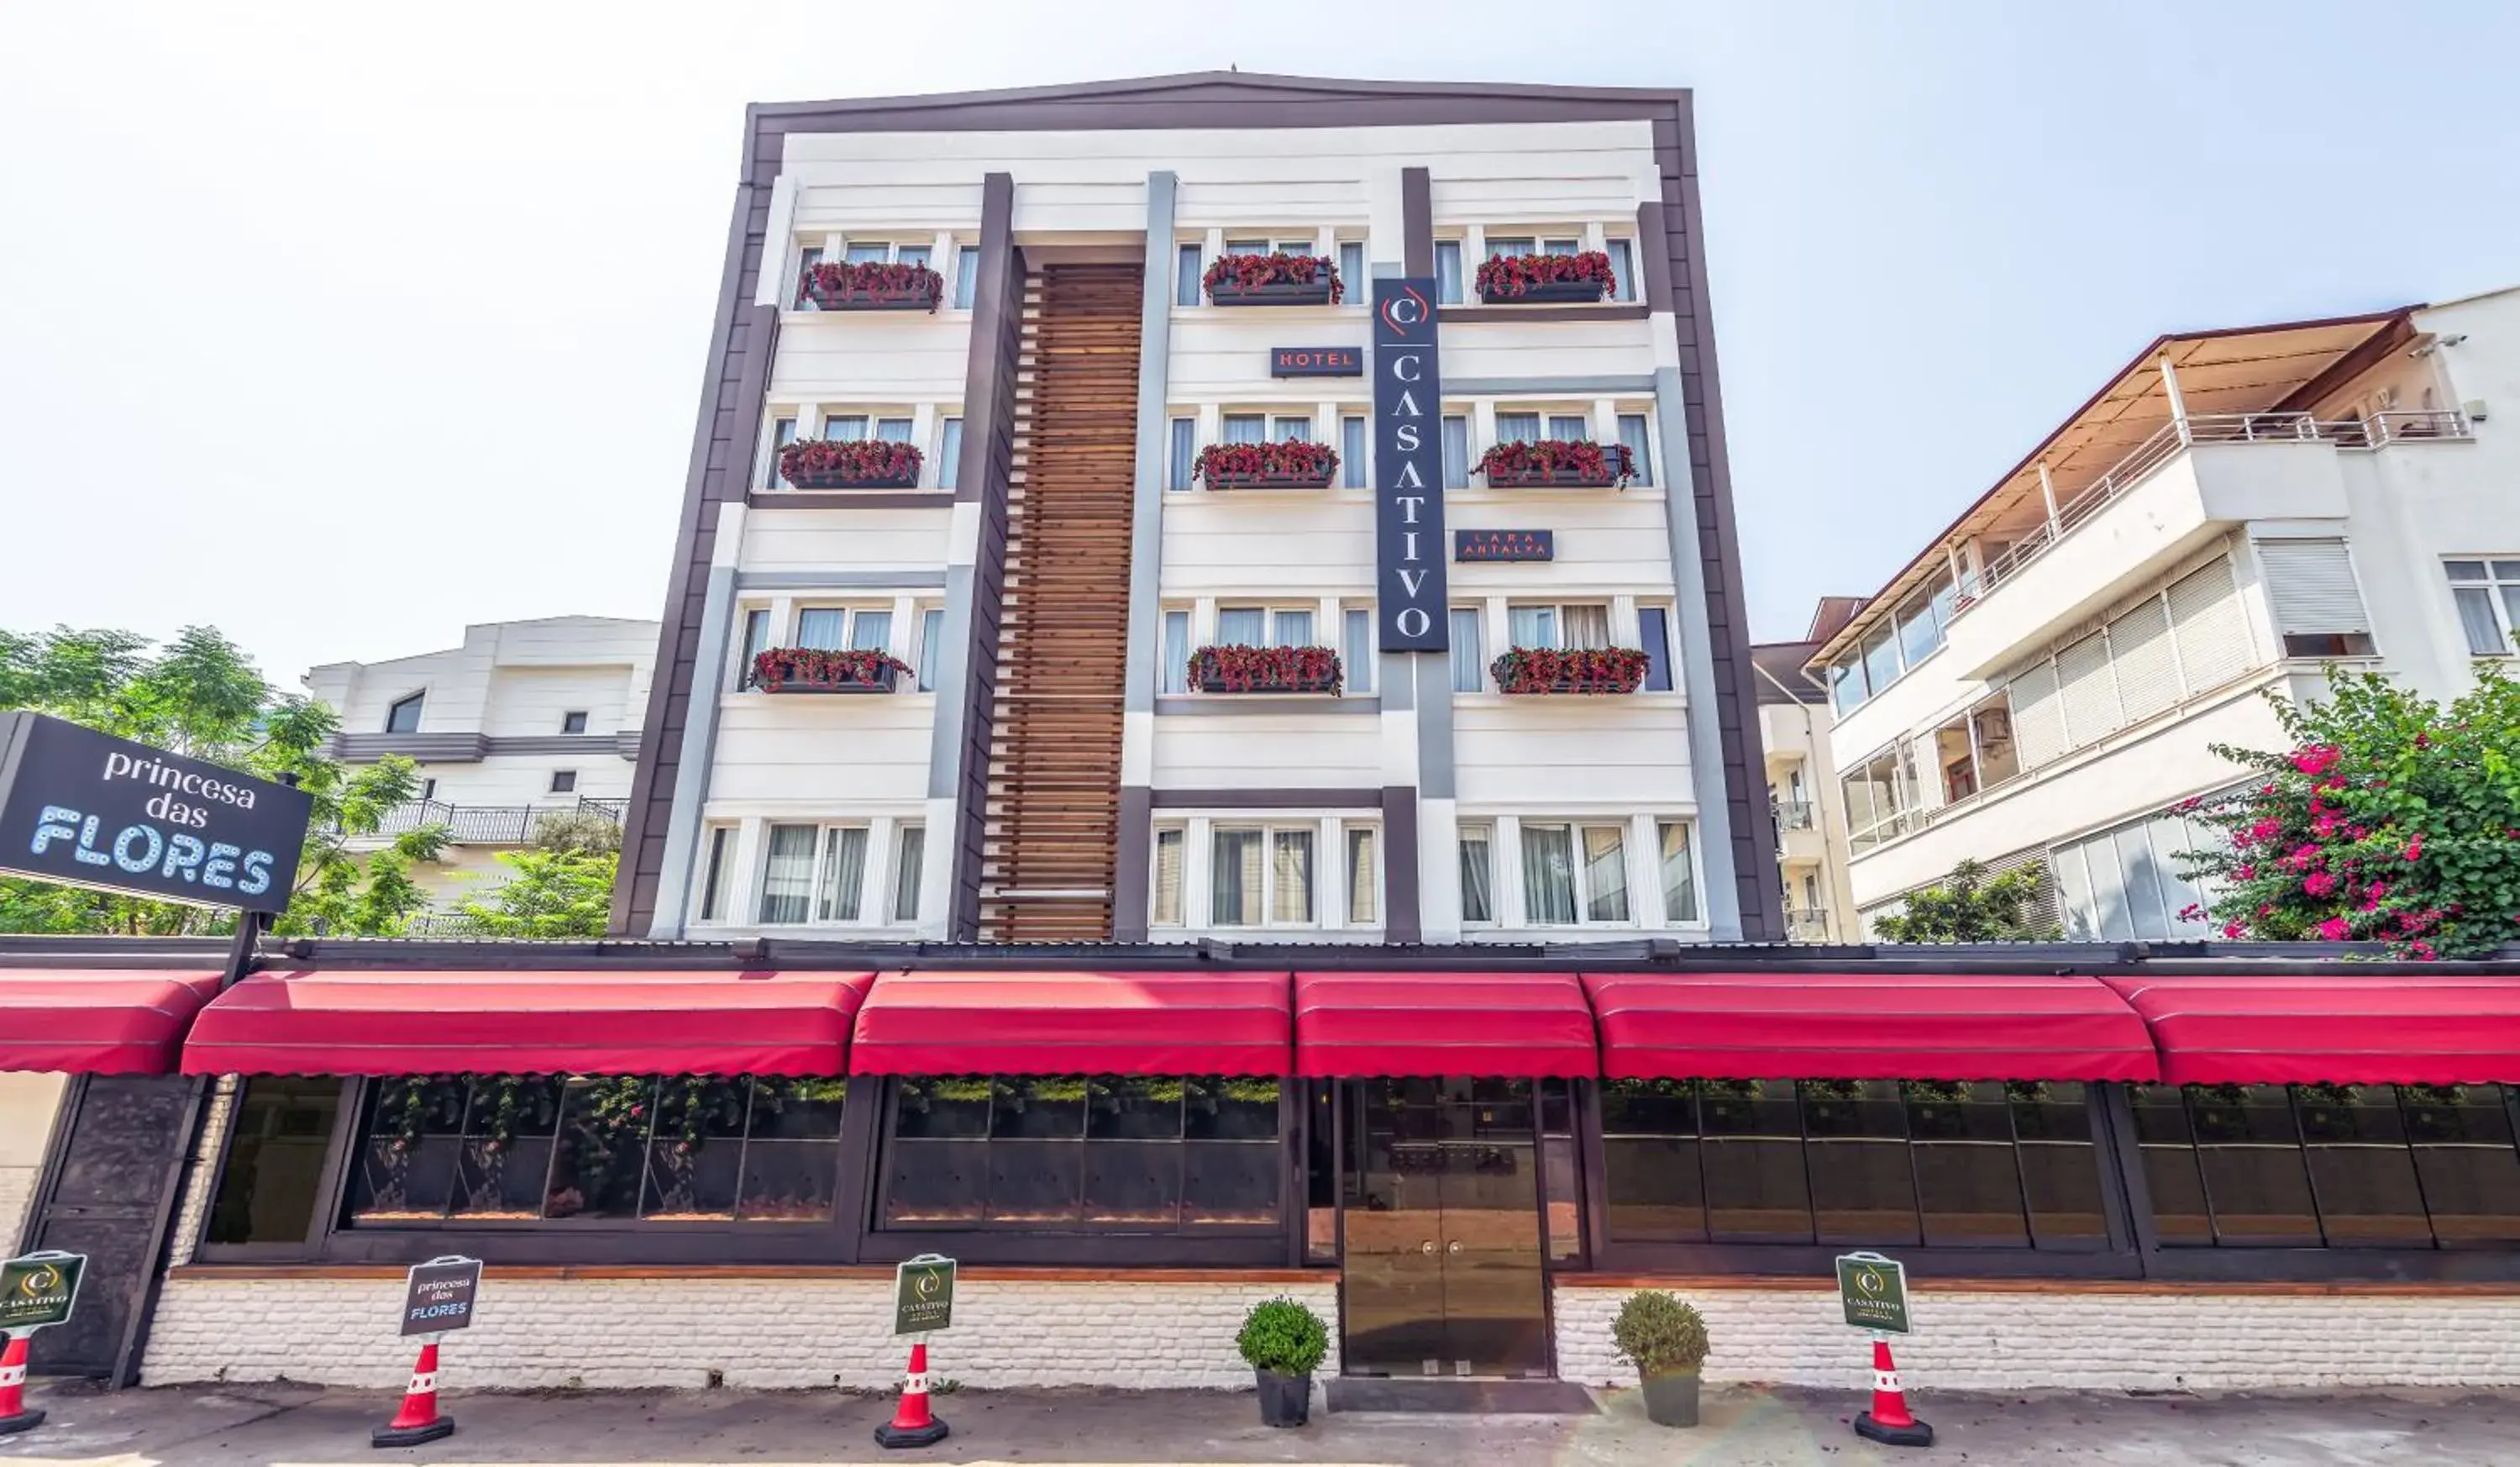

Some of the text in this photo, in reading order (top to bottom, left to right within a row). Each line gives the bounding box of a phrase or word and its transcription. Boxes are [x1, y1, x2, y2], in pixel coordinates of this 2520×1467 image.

[1279, 353, 1354, 366] HOTEL
[1391, 354, 1431, 638] CASATIVO
[1474, 533, 1533, 543] LARA
[1464, 544, 1545, 556] ANTALYA
[102, 751, 256, 810] princesa
[145, 792, 209, 828] das
[30, 804, 275, 896] FLORES
[417, 1277, 470, 1294] princesa
[431, 1291, 454, 1301] das
[410, 1302, 467, 1320] FLORES
